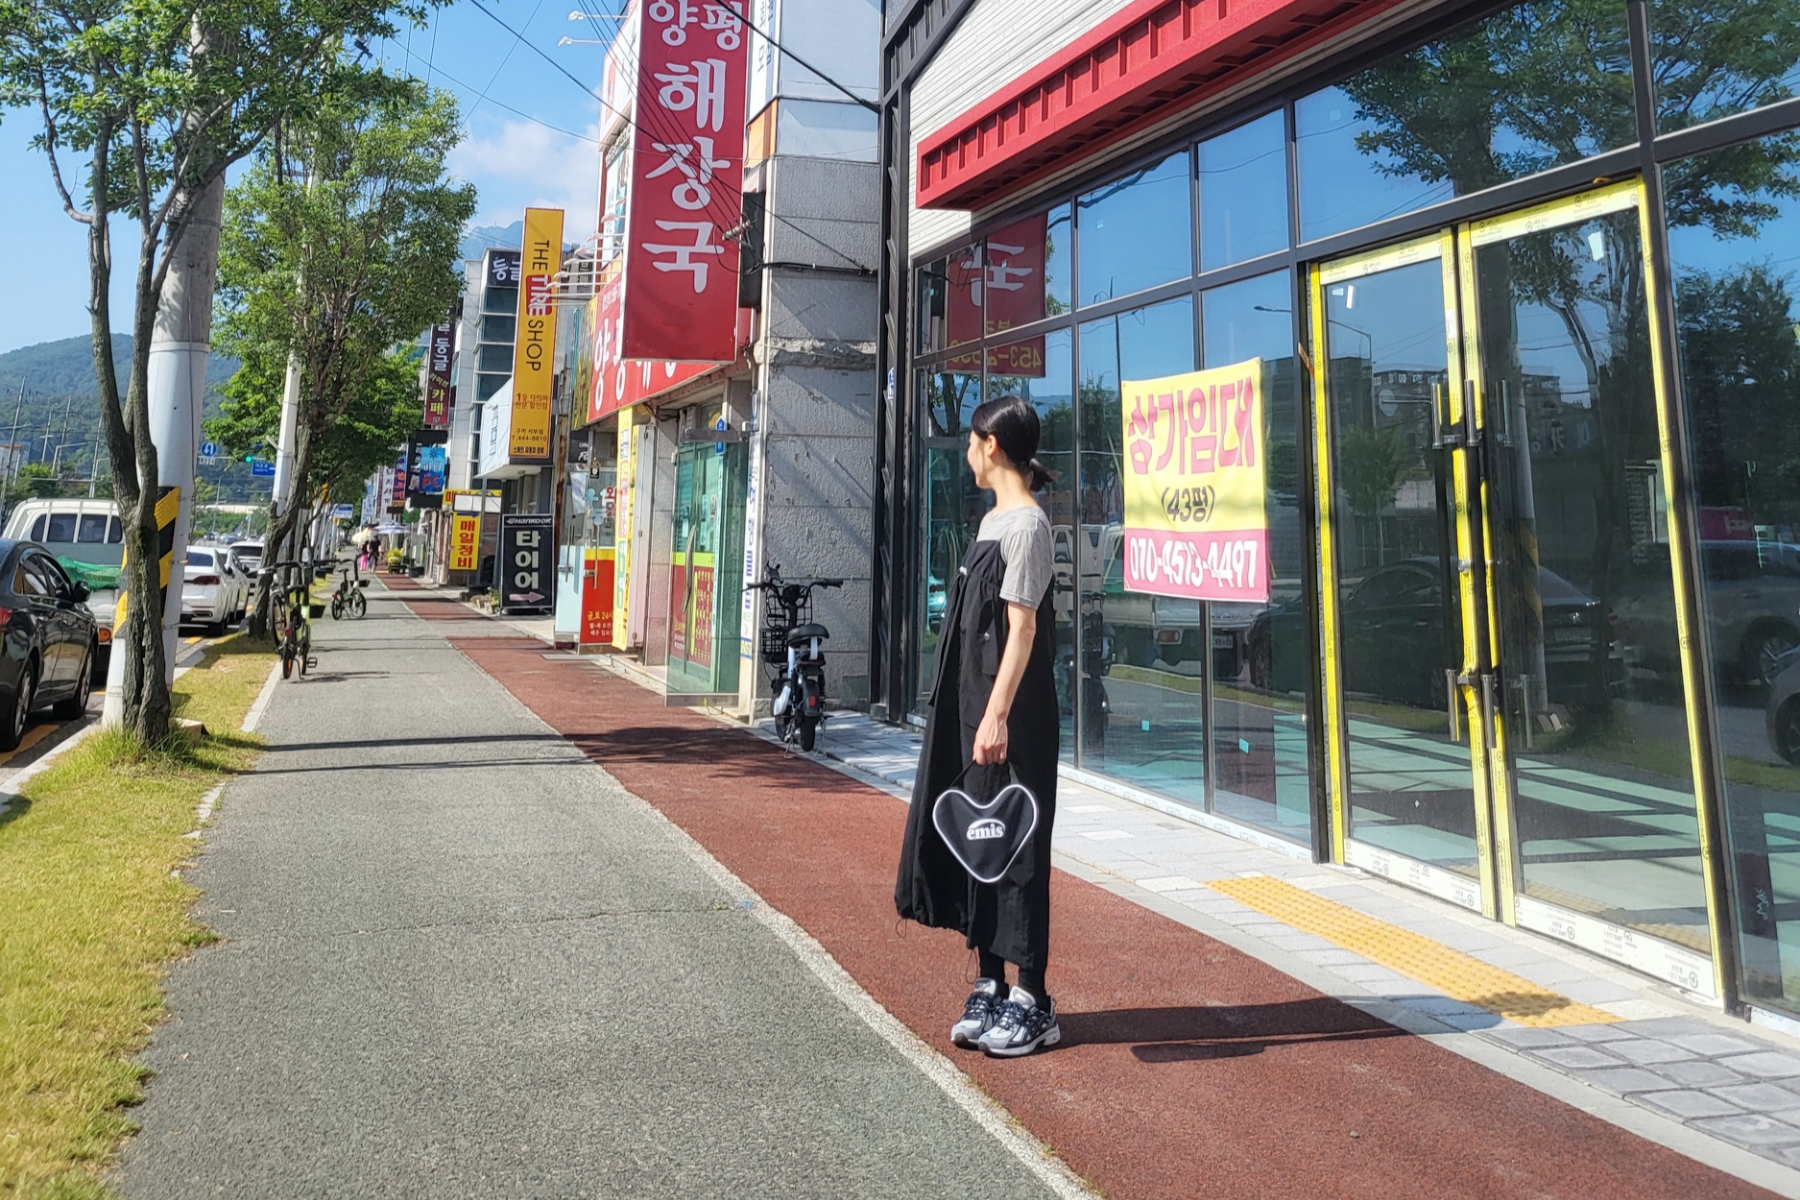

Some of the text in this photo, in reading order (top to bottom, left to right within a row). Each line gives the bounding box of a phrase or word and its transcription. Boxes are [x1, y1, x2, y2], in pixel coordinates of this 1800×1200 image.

[641, 58, 731, 294] 해장국
[525, 240, 550, 371] THE TIRE SHOP
[429, 388, 446, 416] 카페
[1128, 377, 1255, 475] 상가임대
[1161, 485, 1216, 523] (43평)
[457, 520, 476, 568] 매일정비
[514, 530, 541, 590] 타이어
[967, 821, 1003, 840] emis
